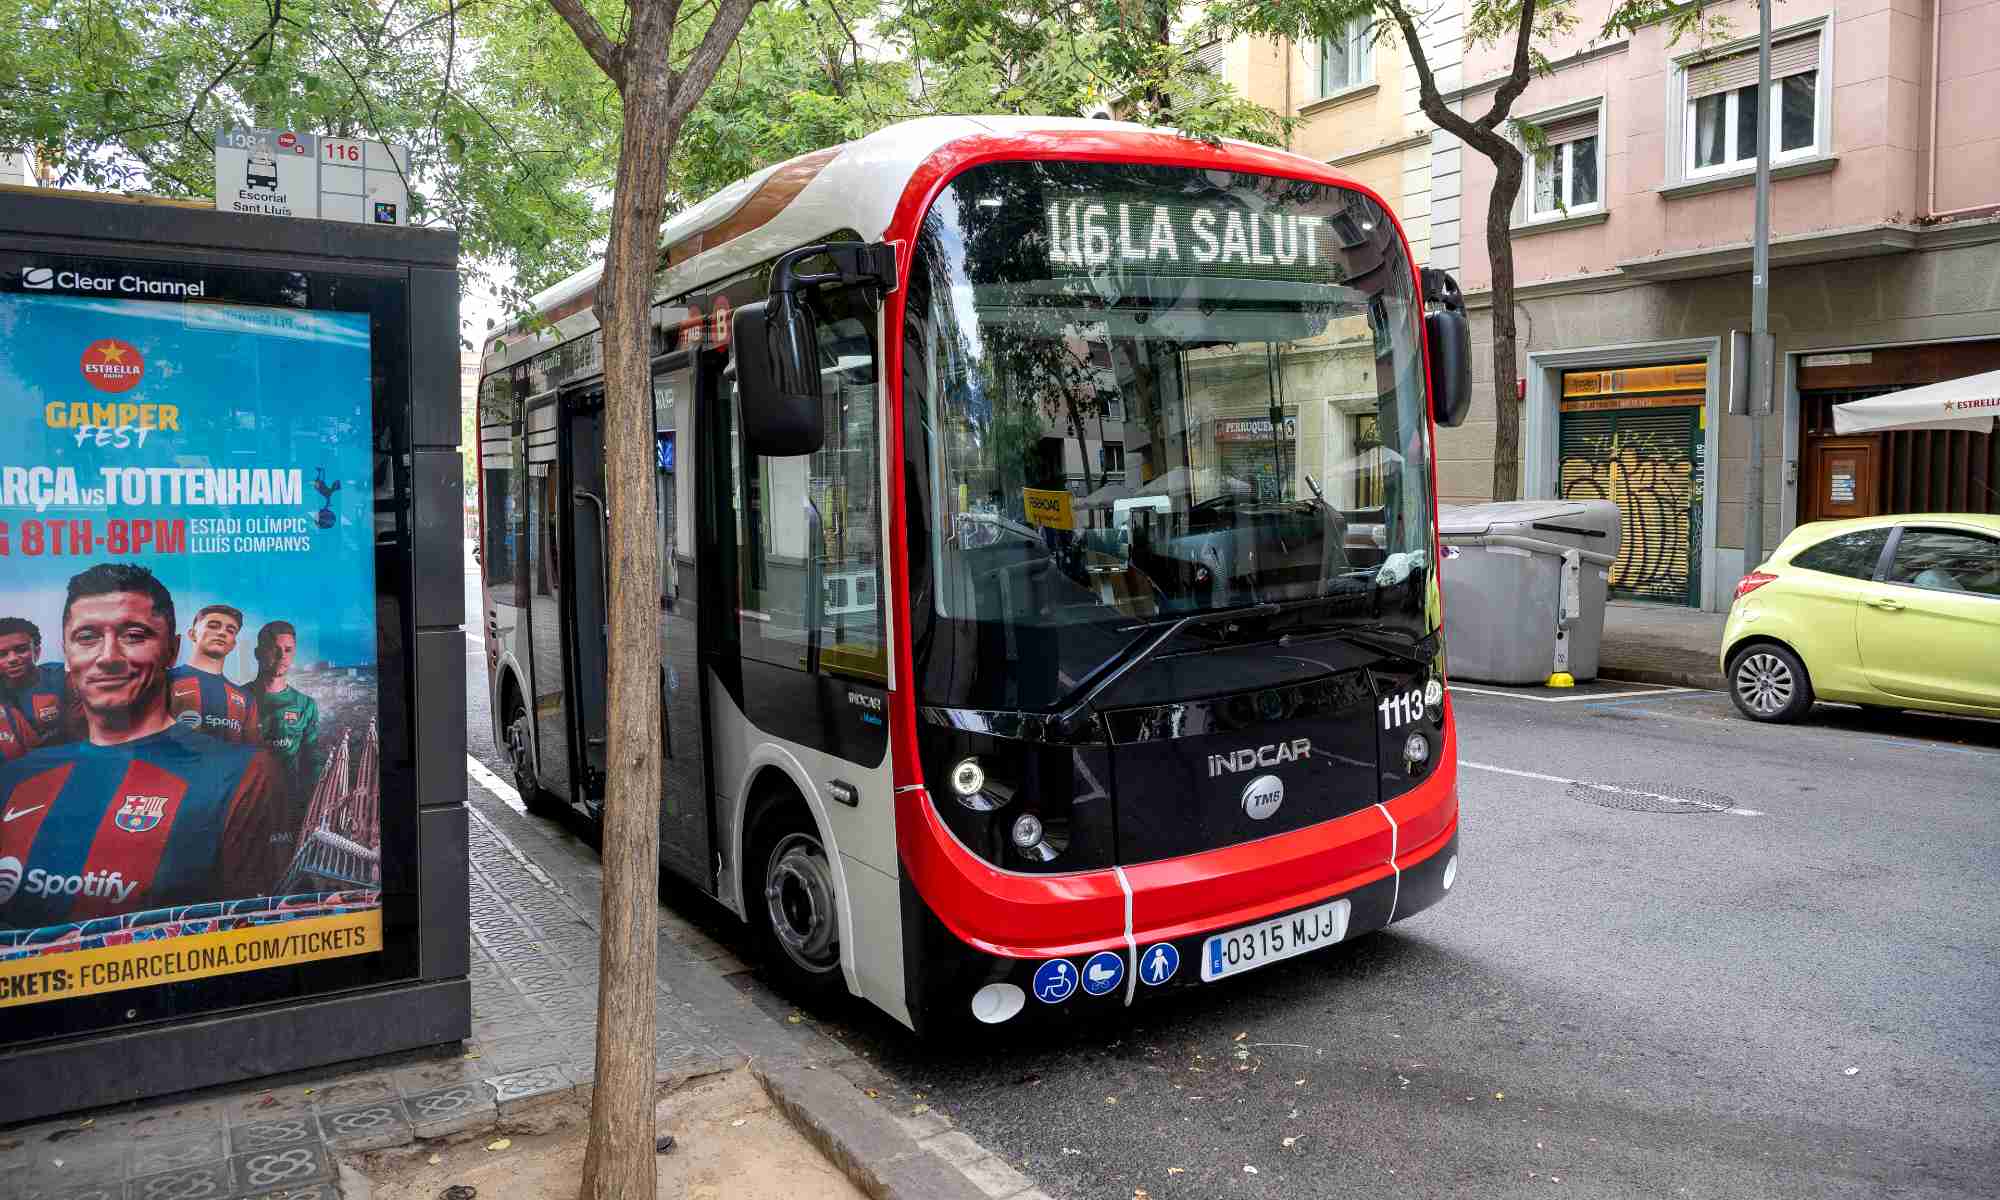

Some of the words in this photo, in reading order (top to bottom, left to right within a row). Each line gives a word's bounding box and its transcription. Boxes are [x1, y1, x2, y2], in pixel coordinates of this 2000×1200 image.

[325, 143, 359, 161] 116
[233, 201, 260, 213] Sant
[239, 189, 287, 203] Escorial
[1047, 202, 1110, 265] 116
[1119, 204, 1179, 260] LA
[1192, 209, 1323, 266] SALUT
[57, 271, 116, 291] Clear
[119, 276, 205, 296] Channel
[85, 363, 141, 375] ESTRELLA
[46, 400, 181, 431] GAMPER
[74, 424, 155, 448] FEST
[0, 466, 79, 512] RÇA
[100, 467, 303, 505] TOTTENHAM
[191, 518, 241, 534] ESTADI
[246, 515, 307, 533] OLÍMPIC
[191, 534, 230, 553] LLUÍS
[234, 535, 311, 553] COMPANYS
[1378, 689, 1424, 730] 1113
[1207, 738, 1312, 777] INDCAR
[24, 868, 138, 901] Spotify
[1227, 924, 1285, 965] 0315
[1292, 910, 1334, 947] MJJ
[79, 926, 366, 988] FCBARCELONA.COM/TICKETS
